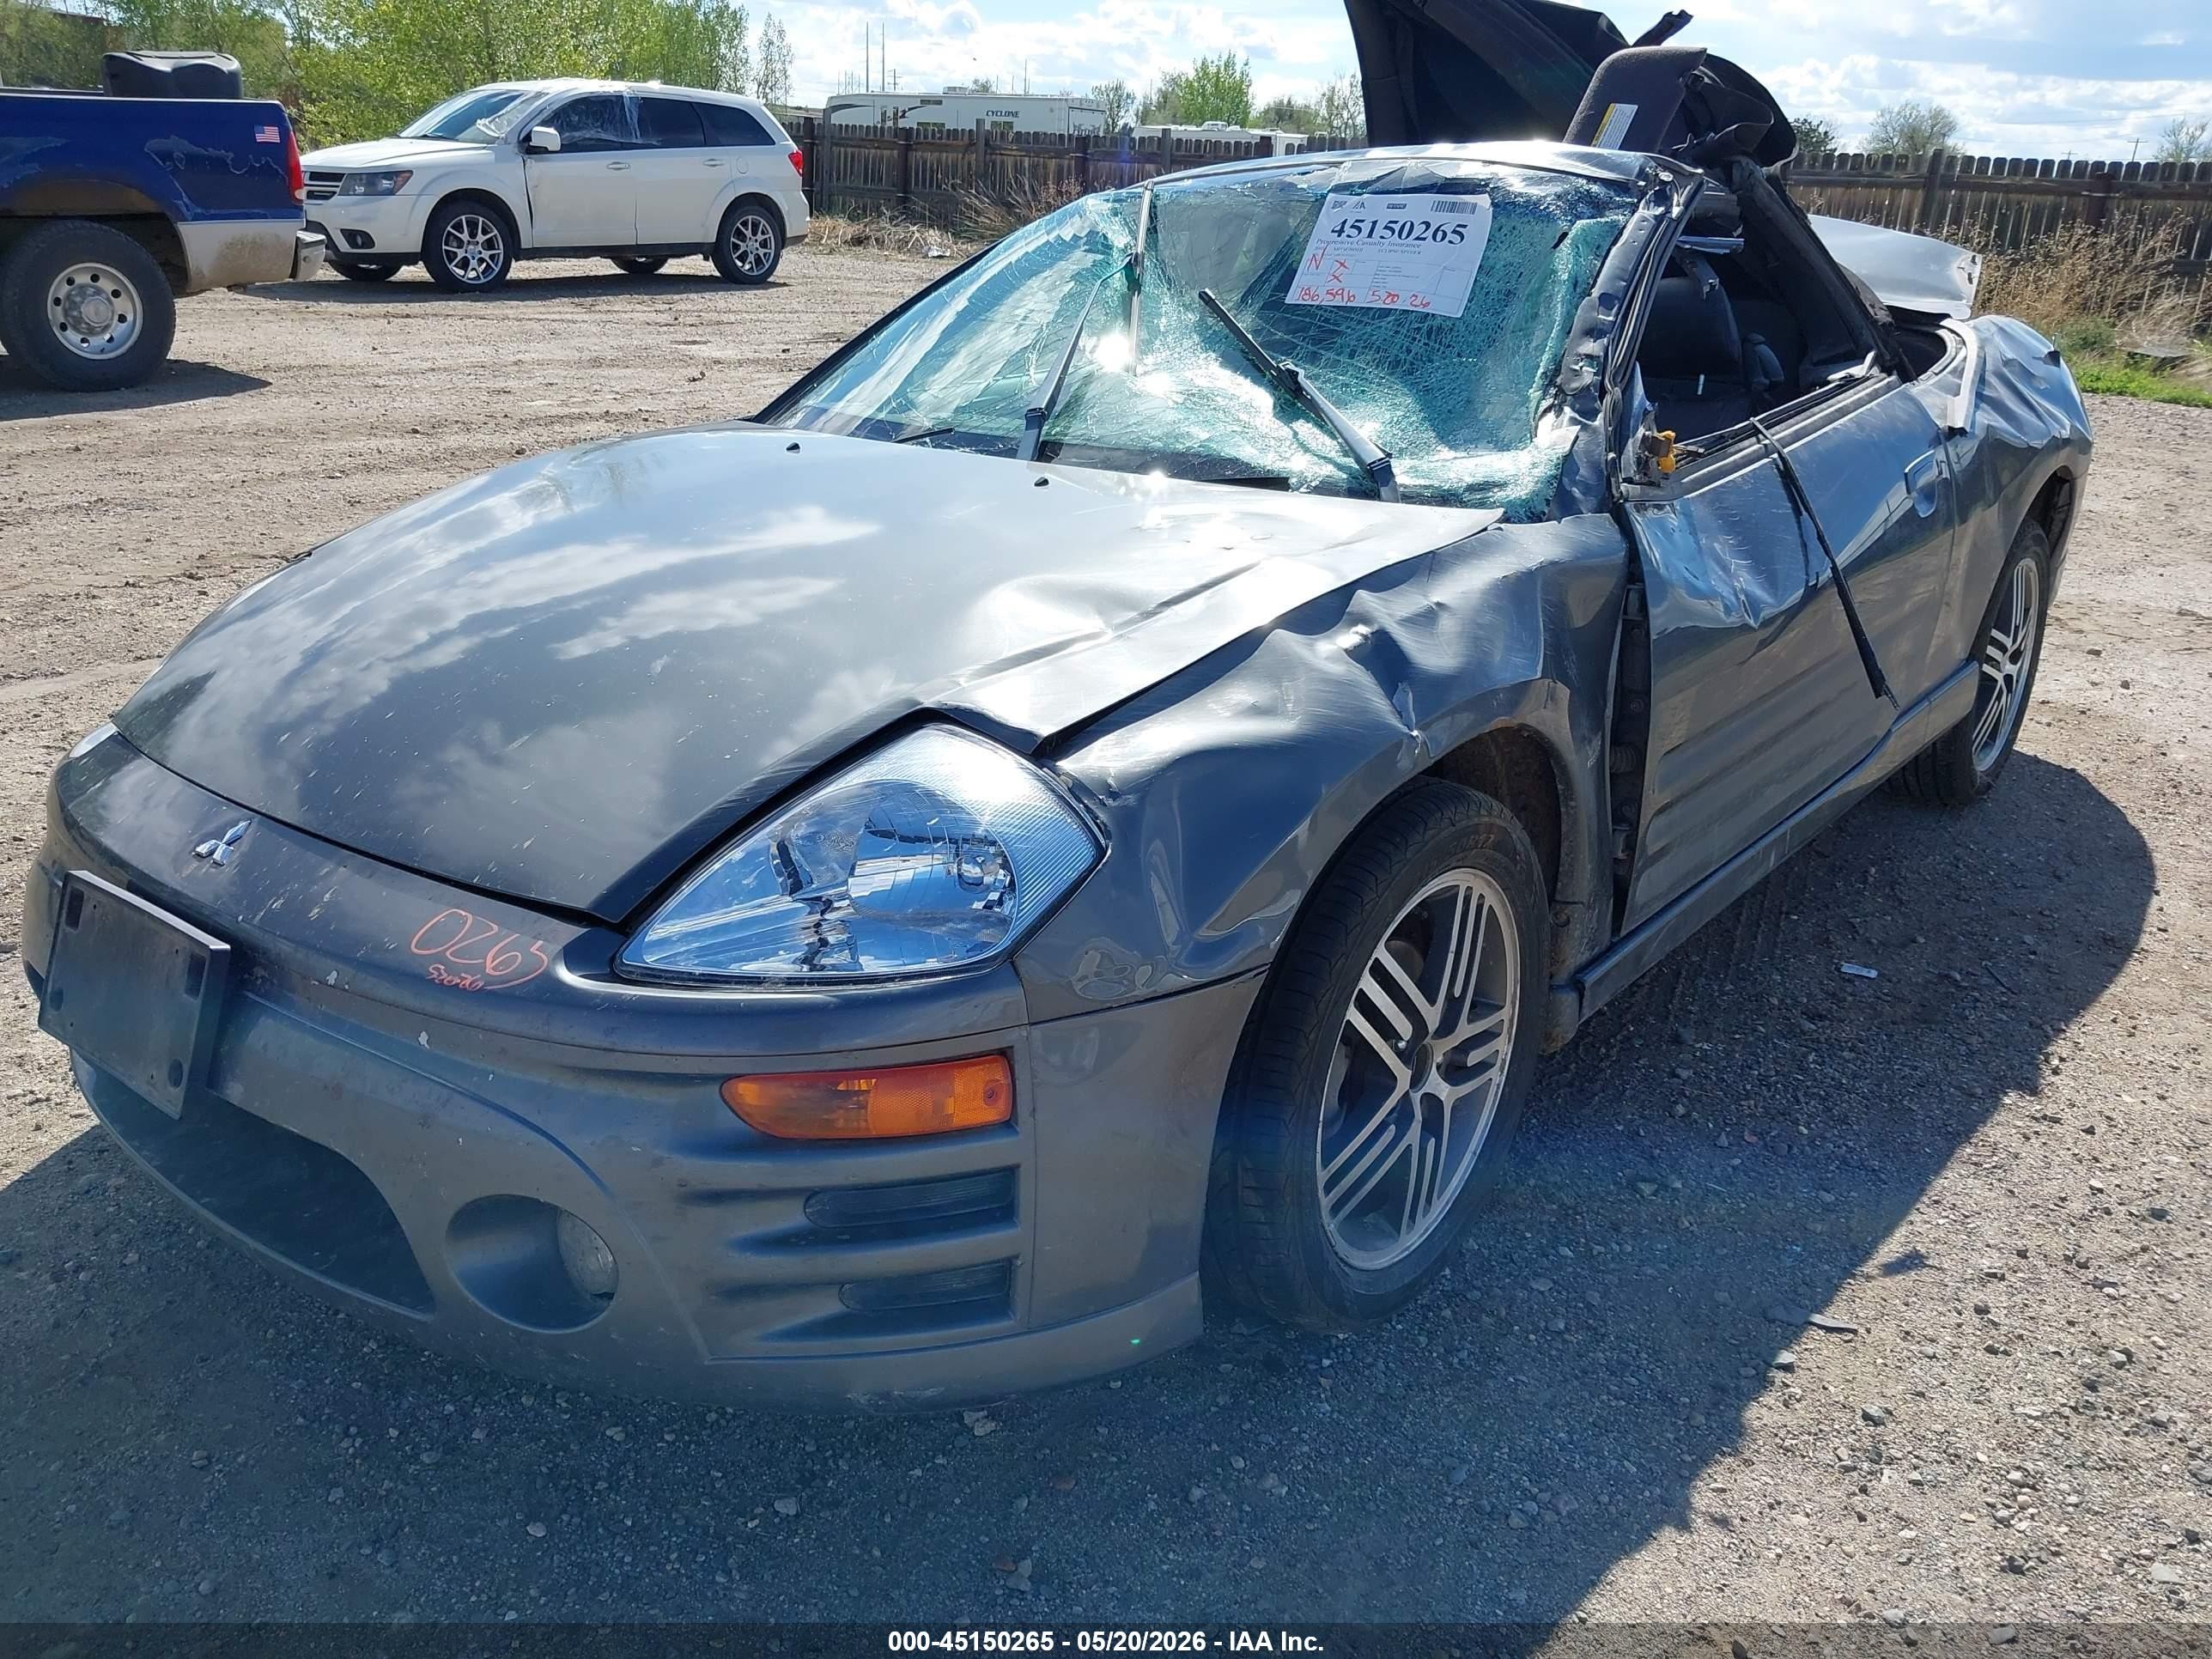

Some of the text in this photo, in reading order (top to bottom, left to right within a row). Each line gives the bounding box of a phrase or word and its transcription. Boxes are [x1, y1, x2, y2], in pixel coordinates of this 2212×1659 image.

[986, 109, 1020, 118] CYCLONE
[1331, 217, 1468, 246] 45150265
[1316, 238, 1422, 249] Progressive Casualty Insurance
